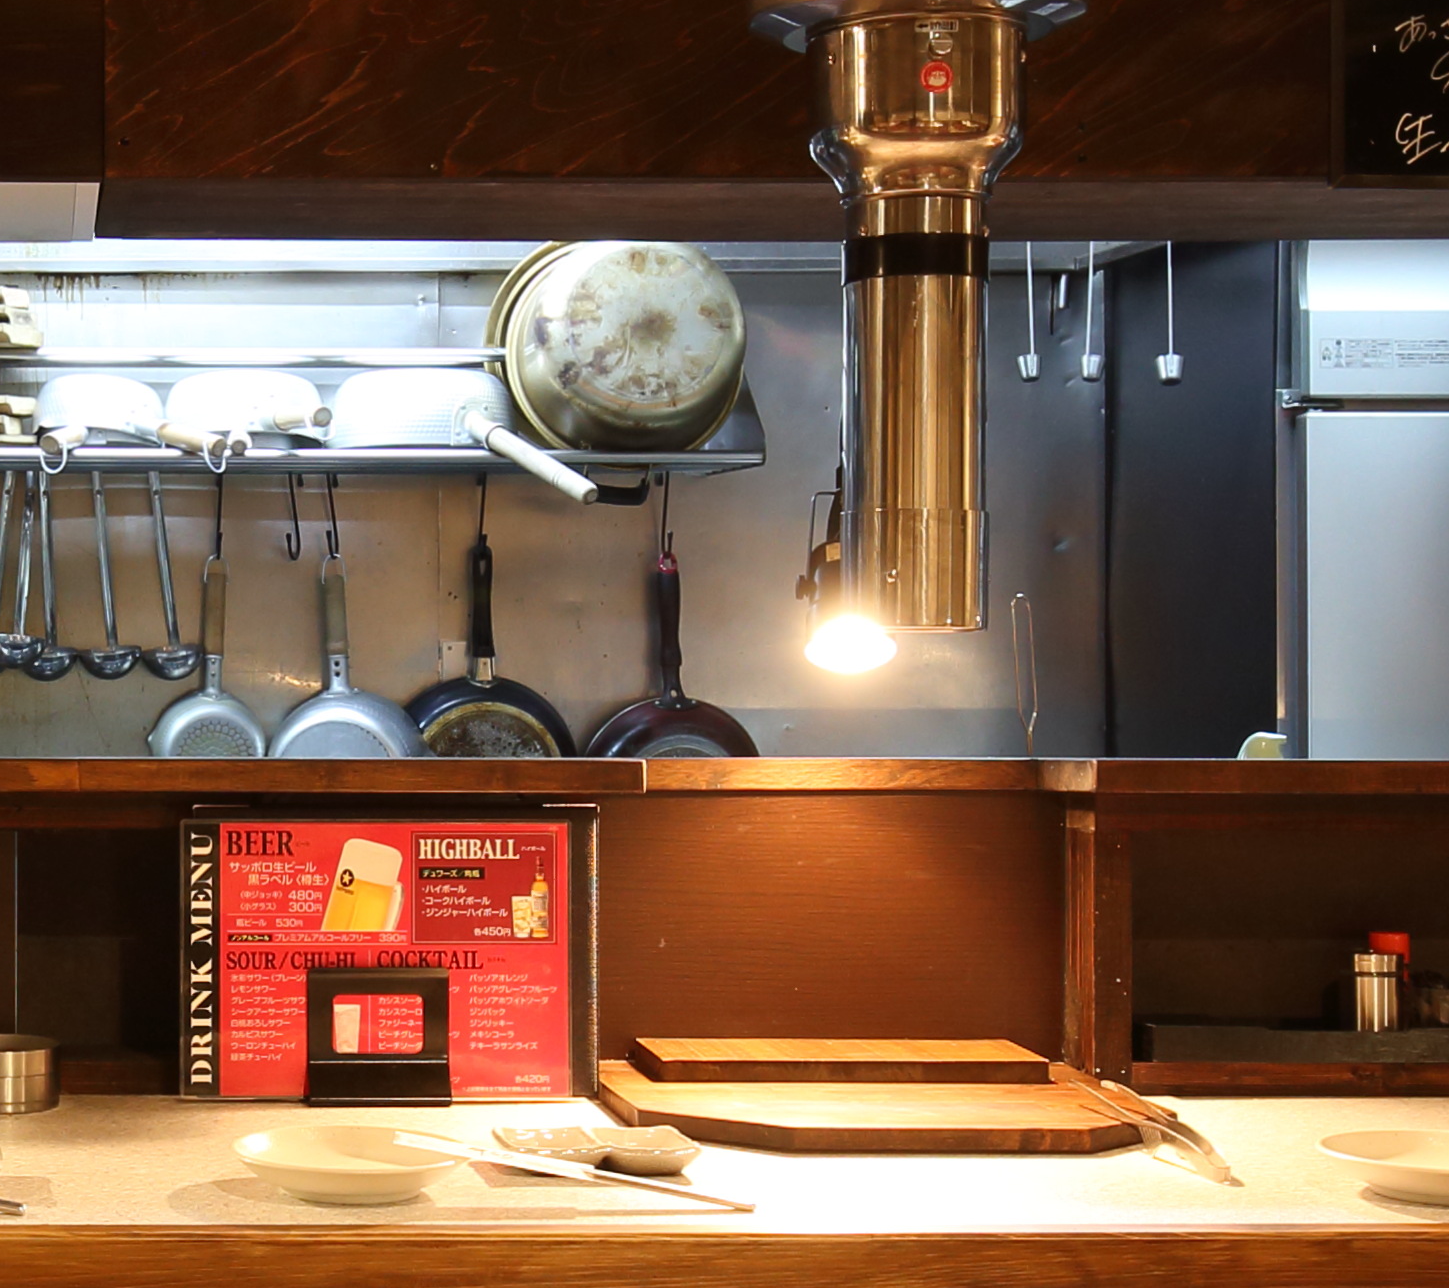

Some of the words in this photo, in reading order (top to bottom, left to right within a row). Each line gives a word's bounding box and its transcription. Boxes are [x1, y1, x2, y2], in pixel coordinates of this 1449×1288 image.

[226, 830, 294, 857] BEER
[418, 839, 520, 860] HIGHBALL
[229, 861, 317, 874] サッポロ生ビール
[190, 832, 213, 946] MENU
[288, 890, 323, 901] 480円
[289, 902, 323, 912] 300円
[276, 918, 304, 928] 530円
[274, 933, 372, 943] プレミアムアルコールフリー
[377, 950, 484, 970] COCKTAIL
[230, 985, 277, 994] レモンサワー
[190, 958, 213, 1085] DRINK
